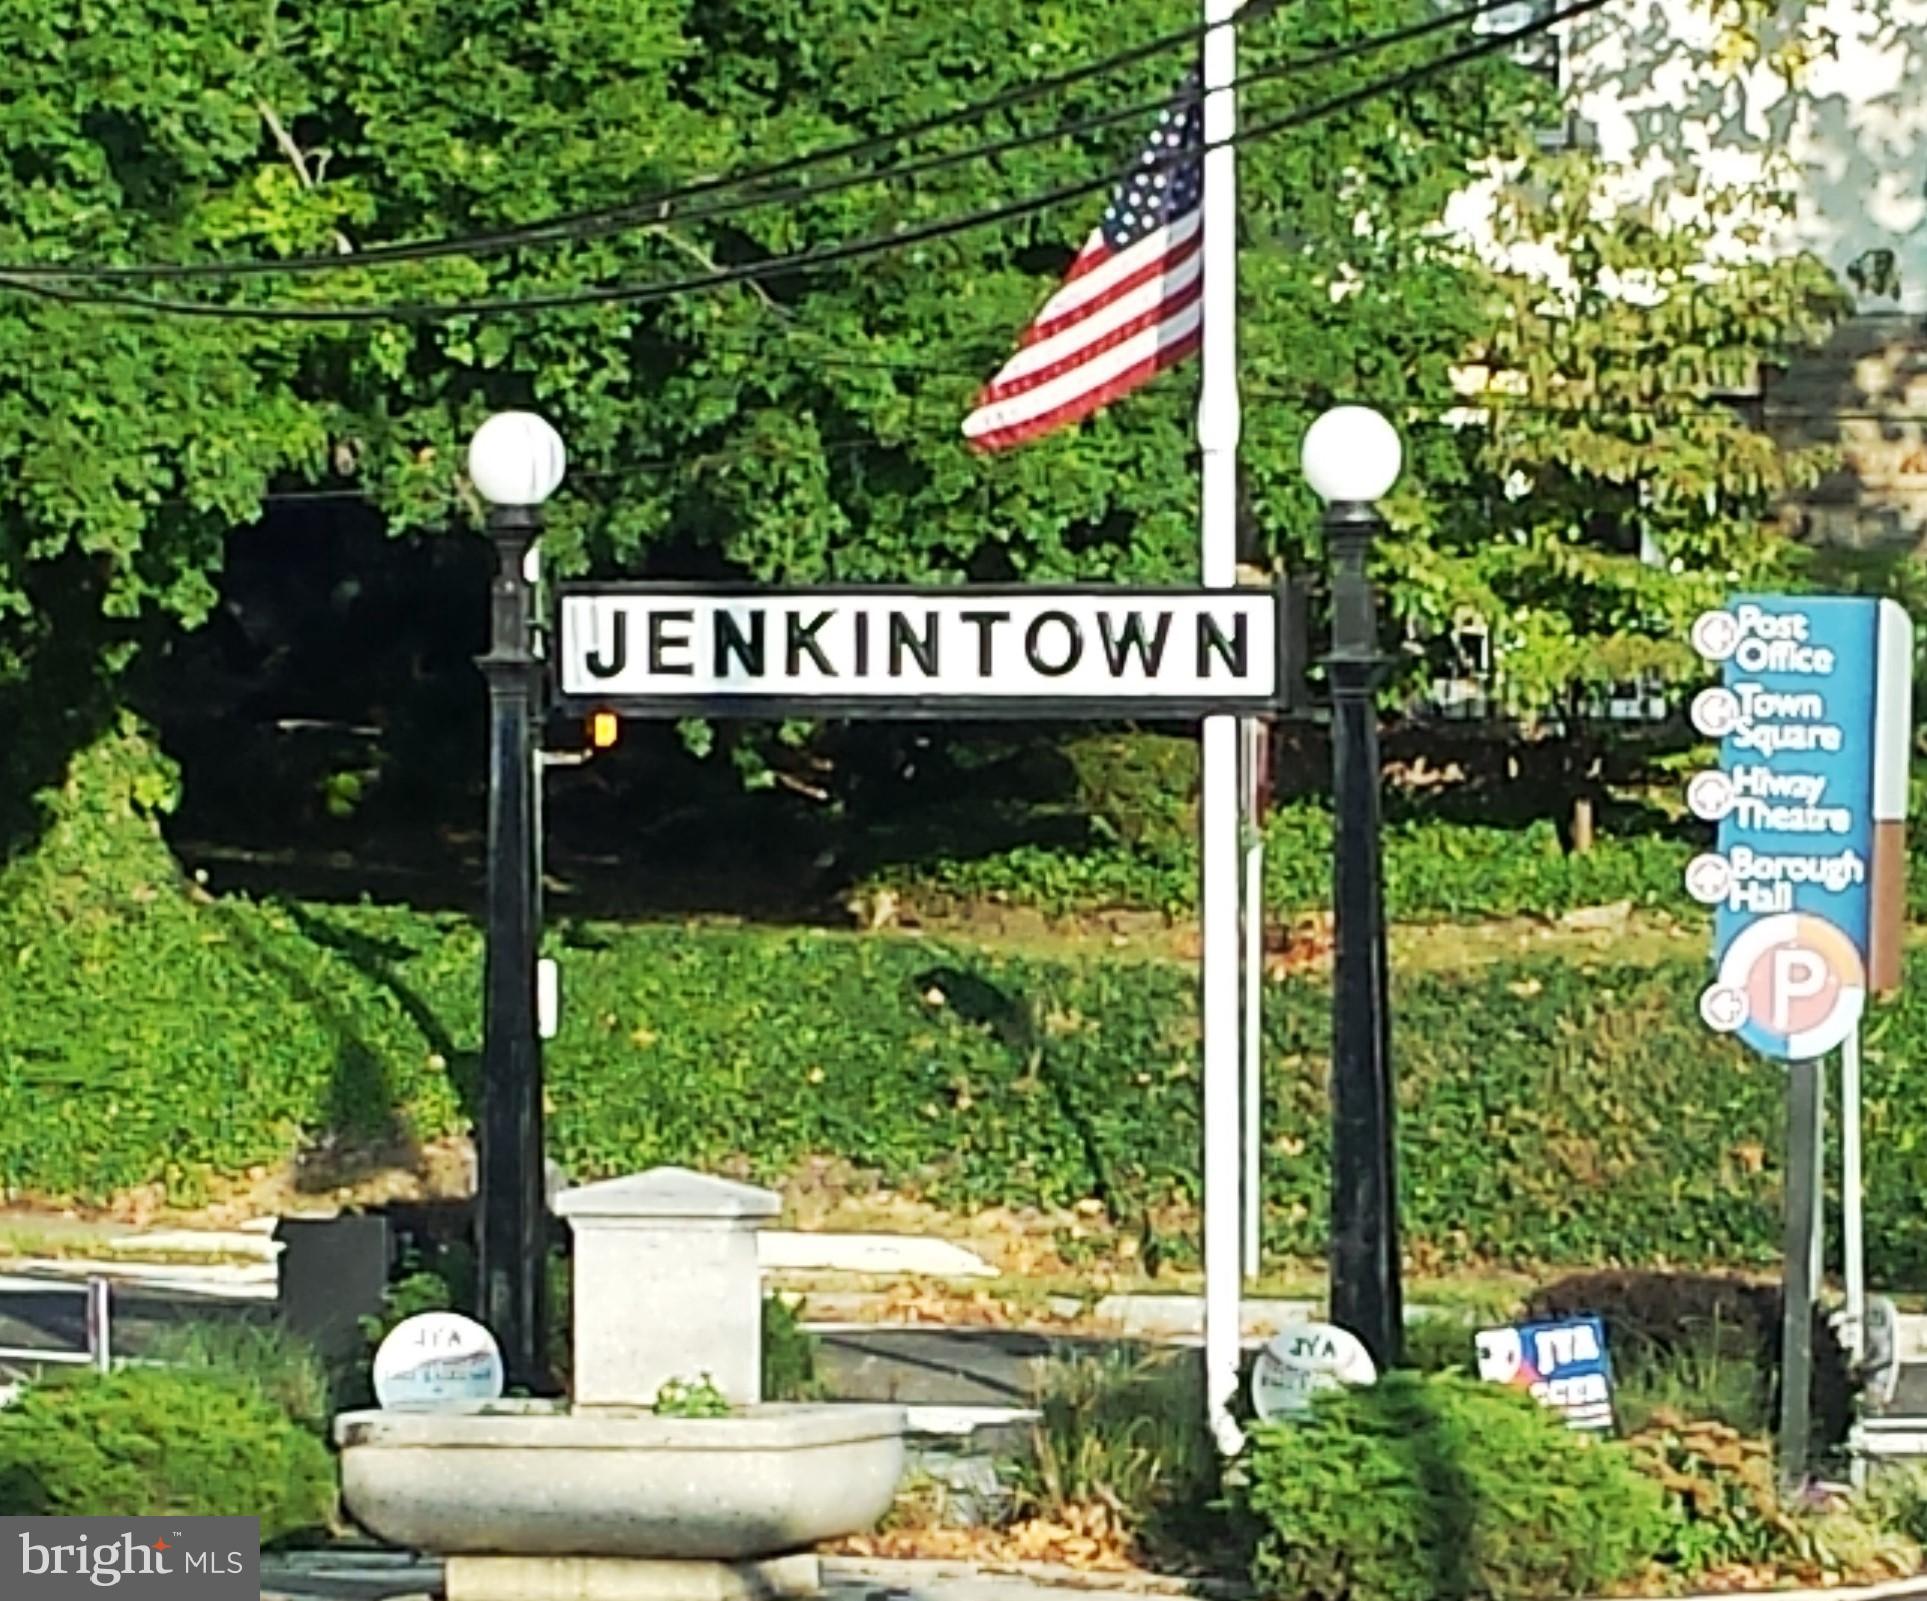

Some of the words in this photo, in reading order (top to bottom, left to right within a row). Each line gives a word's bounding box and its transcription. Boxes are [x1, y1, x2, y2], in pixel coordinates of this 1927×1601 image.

[1738, 604, 1810, 642] Post
[585, 609, 1249, 679] JENKINTOWN
[1735, 637, 1835, 674] Office
[1732, 682, 1823, 720] Town
[1732, 716, 1842, 758] Square
[1732, 764, 1828, 804] Hiway
[1731, 796, 1851, 834] Theatre
[1729, 845, 1865, 892] Borough
[1729, 879, 1793, 913] Hall
[1773, 949, 1828, 1034] P
